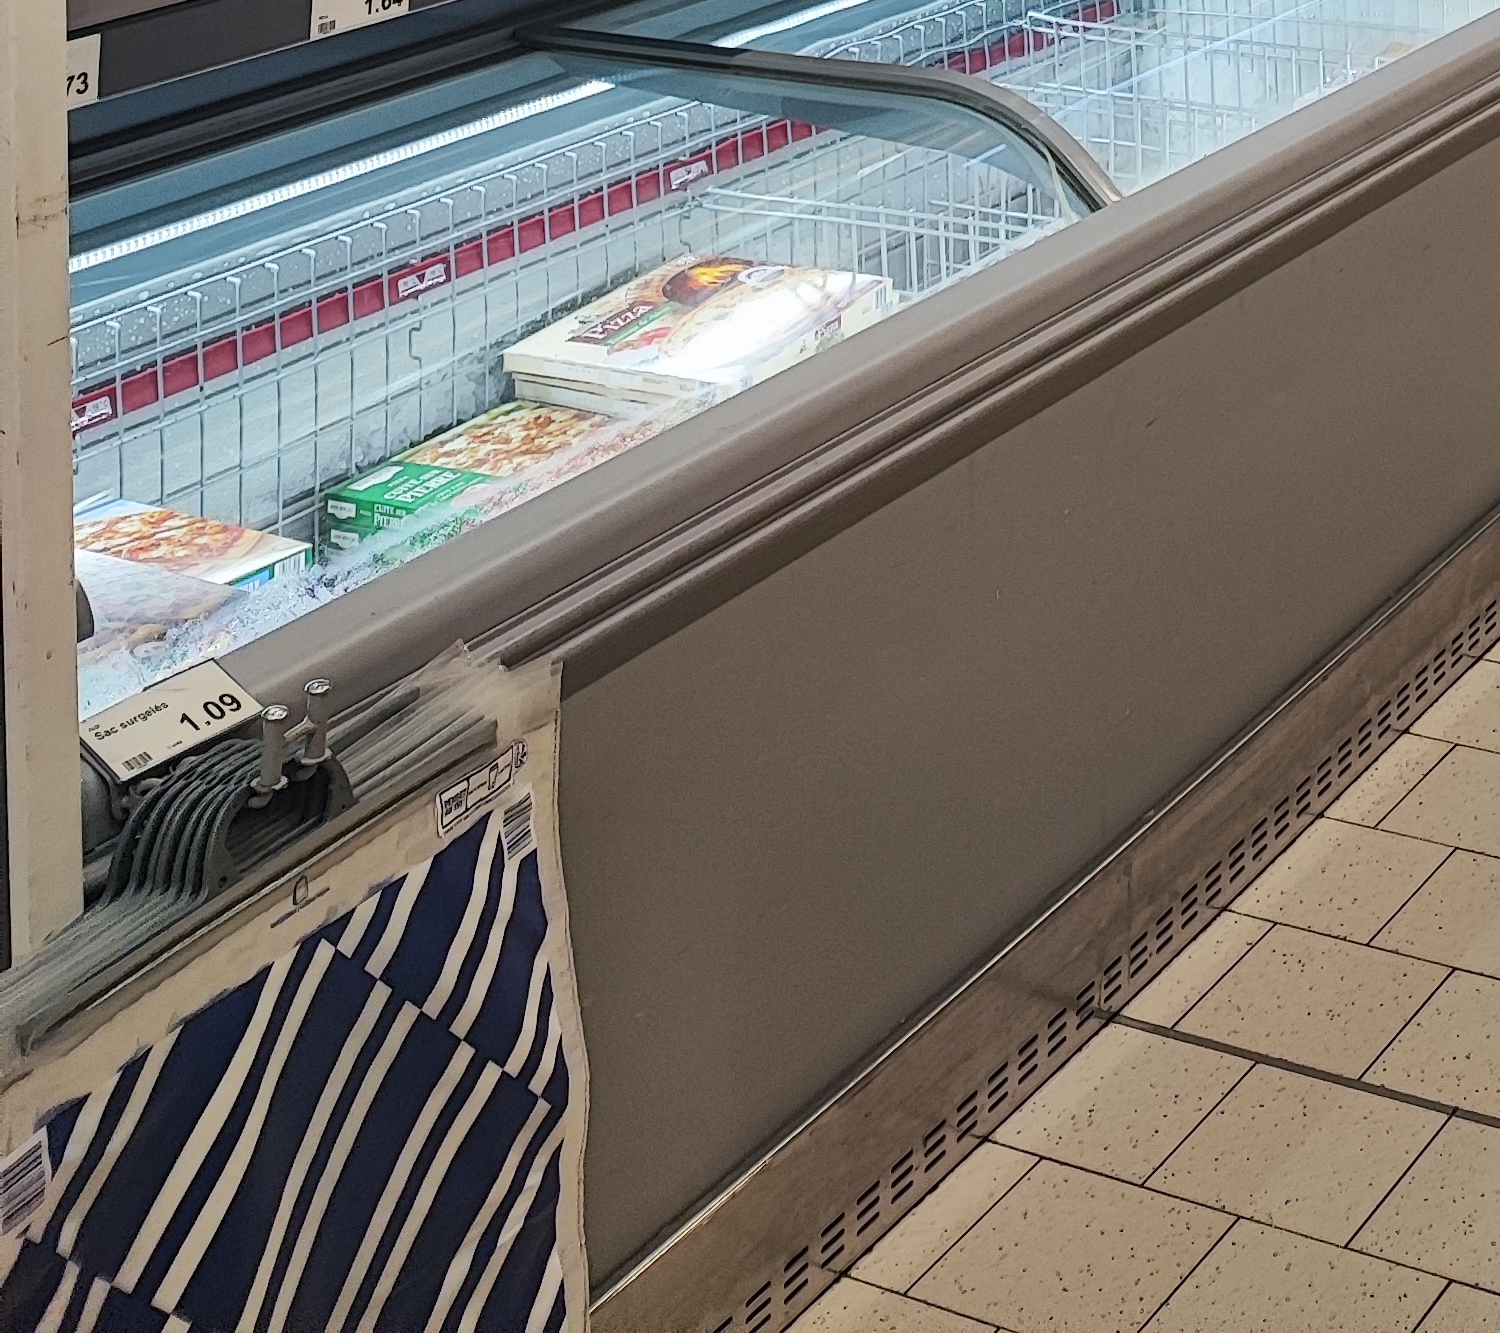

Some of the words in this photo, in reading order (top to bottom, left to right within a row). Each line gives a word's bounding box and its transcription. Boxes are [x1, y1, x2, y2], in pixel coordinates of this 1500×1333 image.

[94, 726, 119, 741] Sac
[119, 700, 170, 731] surgelés
[179, 693, 242, 732] 1.09
